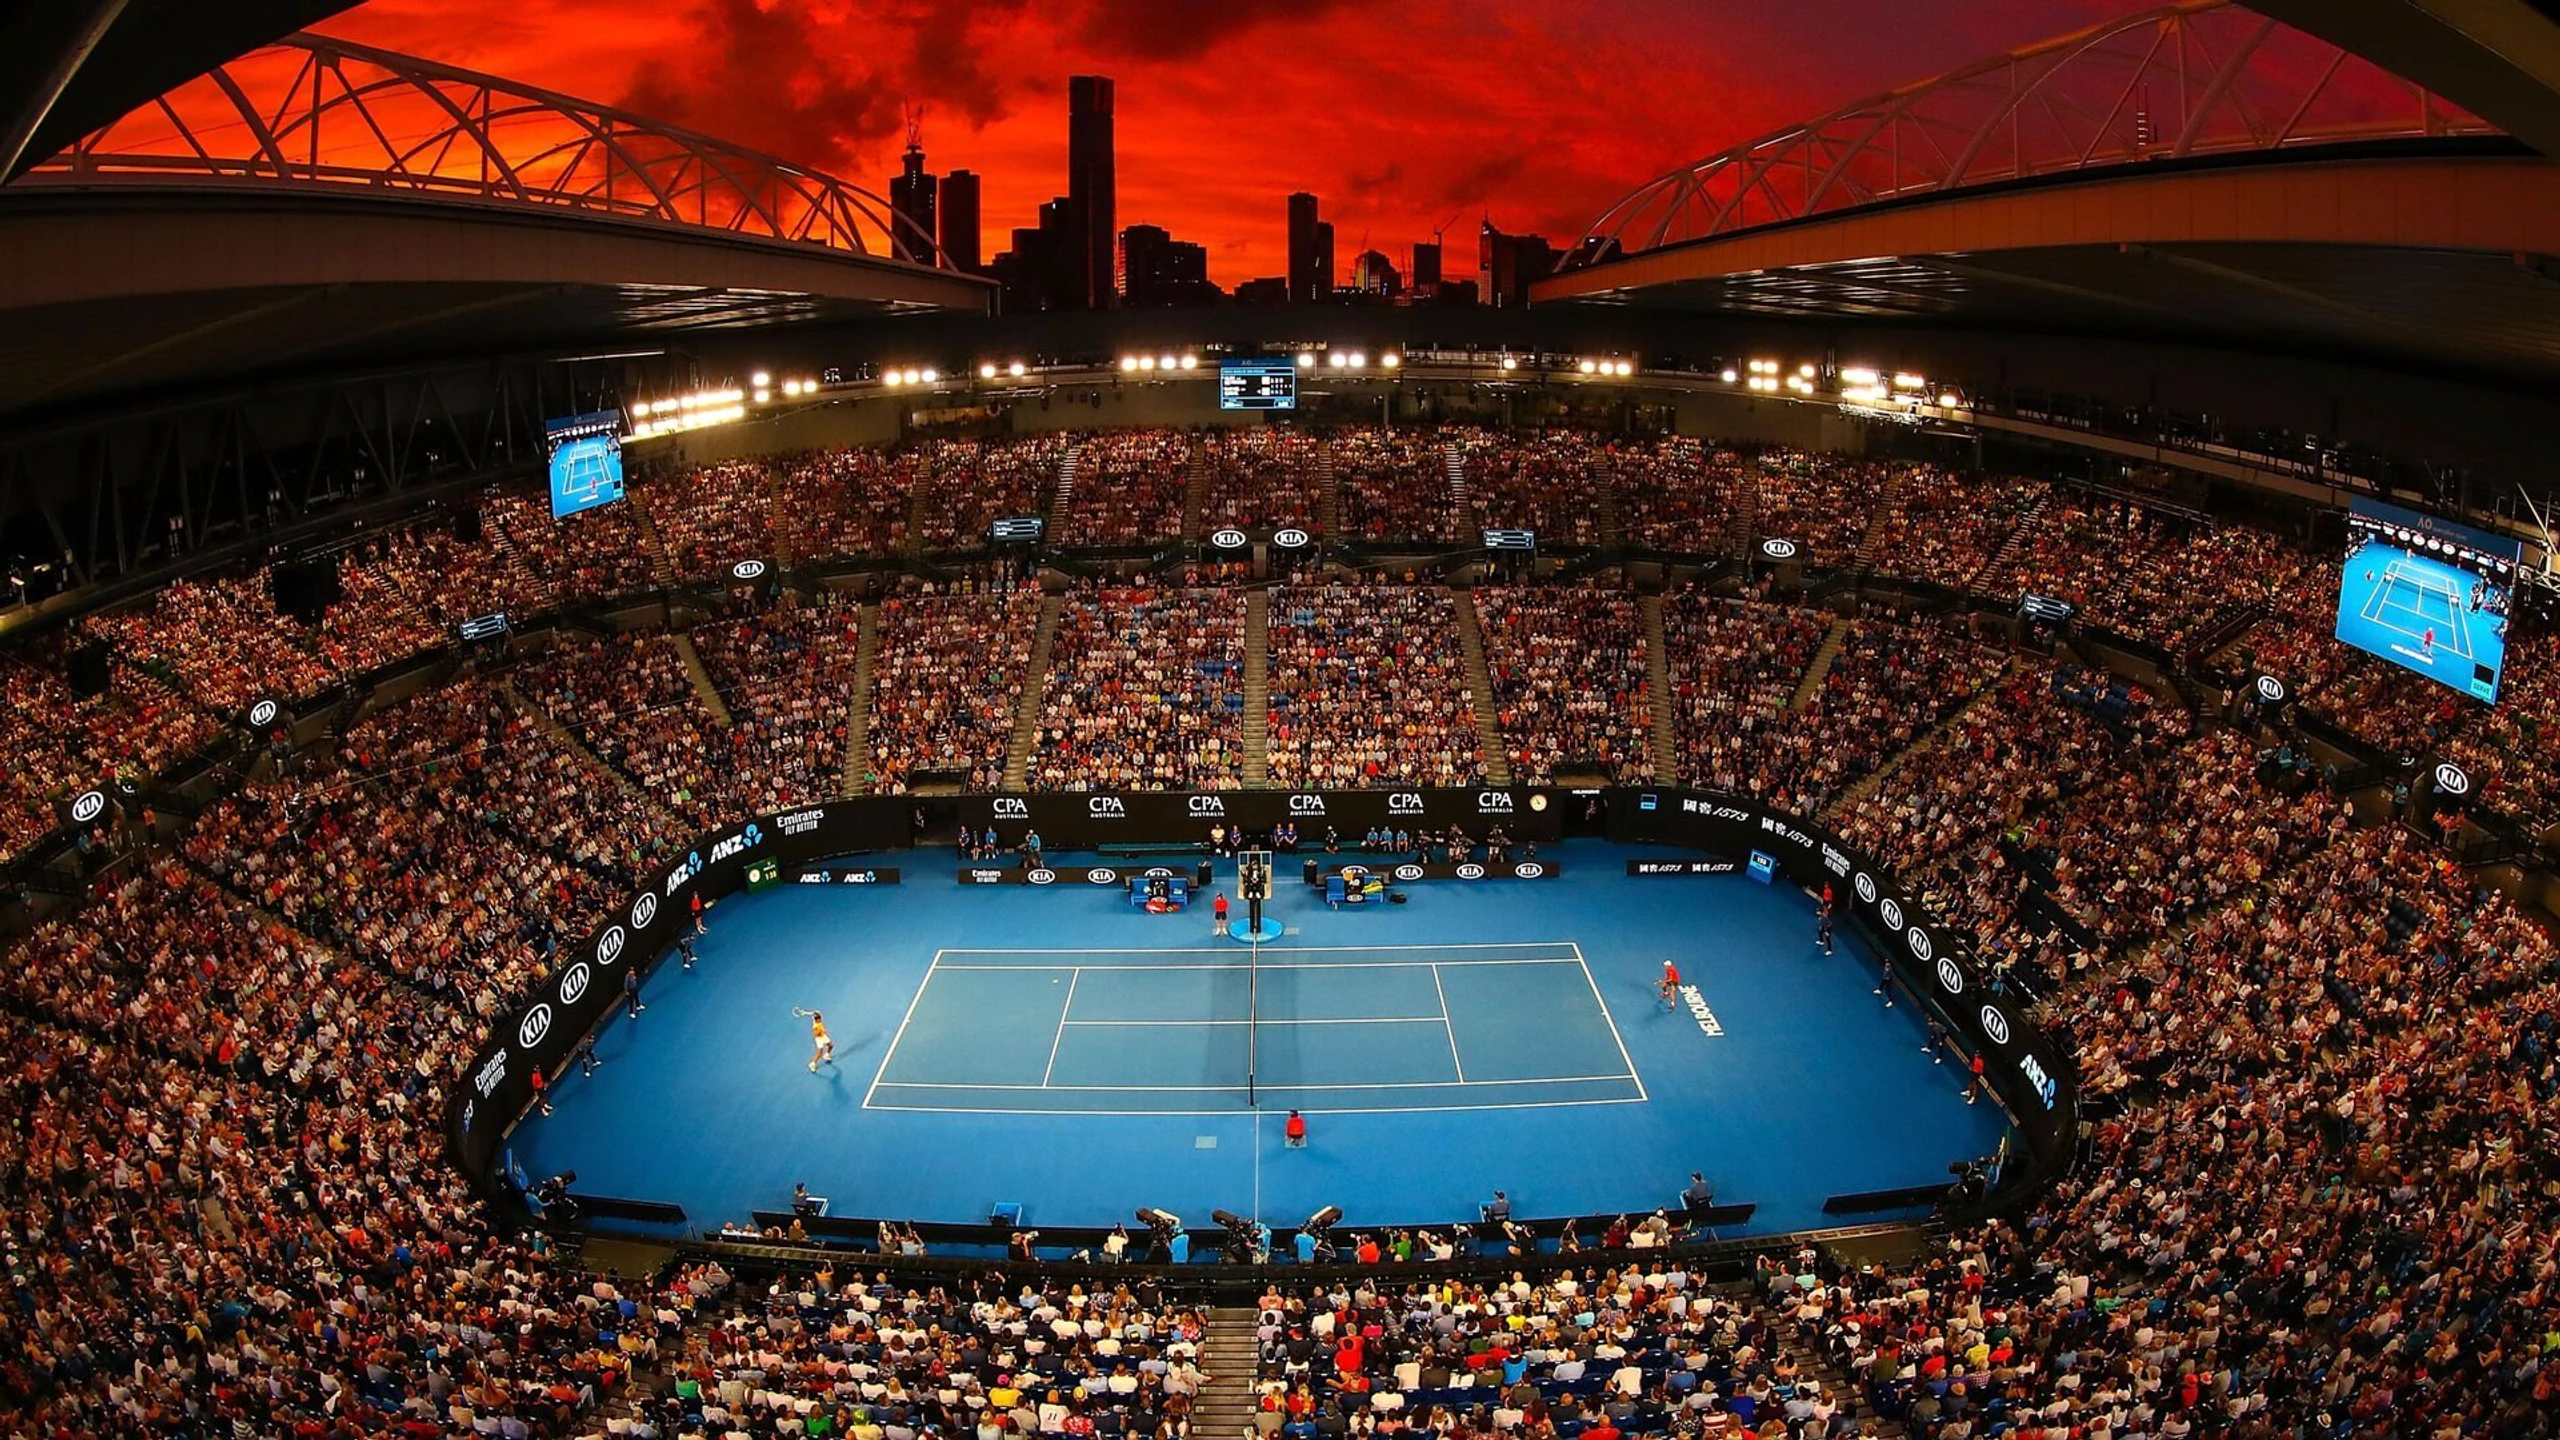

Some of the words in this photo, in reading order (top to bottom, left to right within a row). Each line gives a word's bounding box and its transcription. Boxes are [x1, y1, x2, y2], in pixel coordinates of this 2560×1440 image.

[993, 798, 1028, 813] CPA
[1089, 797, 1125, 812] CPA
[1188, 795, 1224, 811] CPA
[1289, 794, 1325, 809] CPA
[1388, 793, 1424, 808] CPA
[1478, 792, 1513, 806] CPA
[776, 809, 824, 829] Emirates
[710, 834, 744, 864] ANZ
[1821, 842, 1850, 871] Emirates
[666, 863, 689, 897] ANZ
[475, 1047, 507, 1091] Emirates
[2020, 1054, 2047, 1096] ANZ
